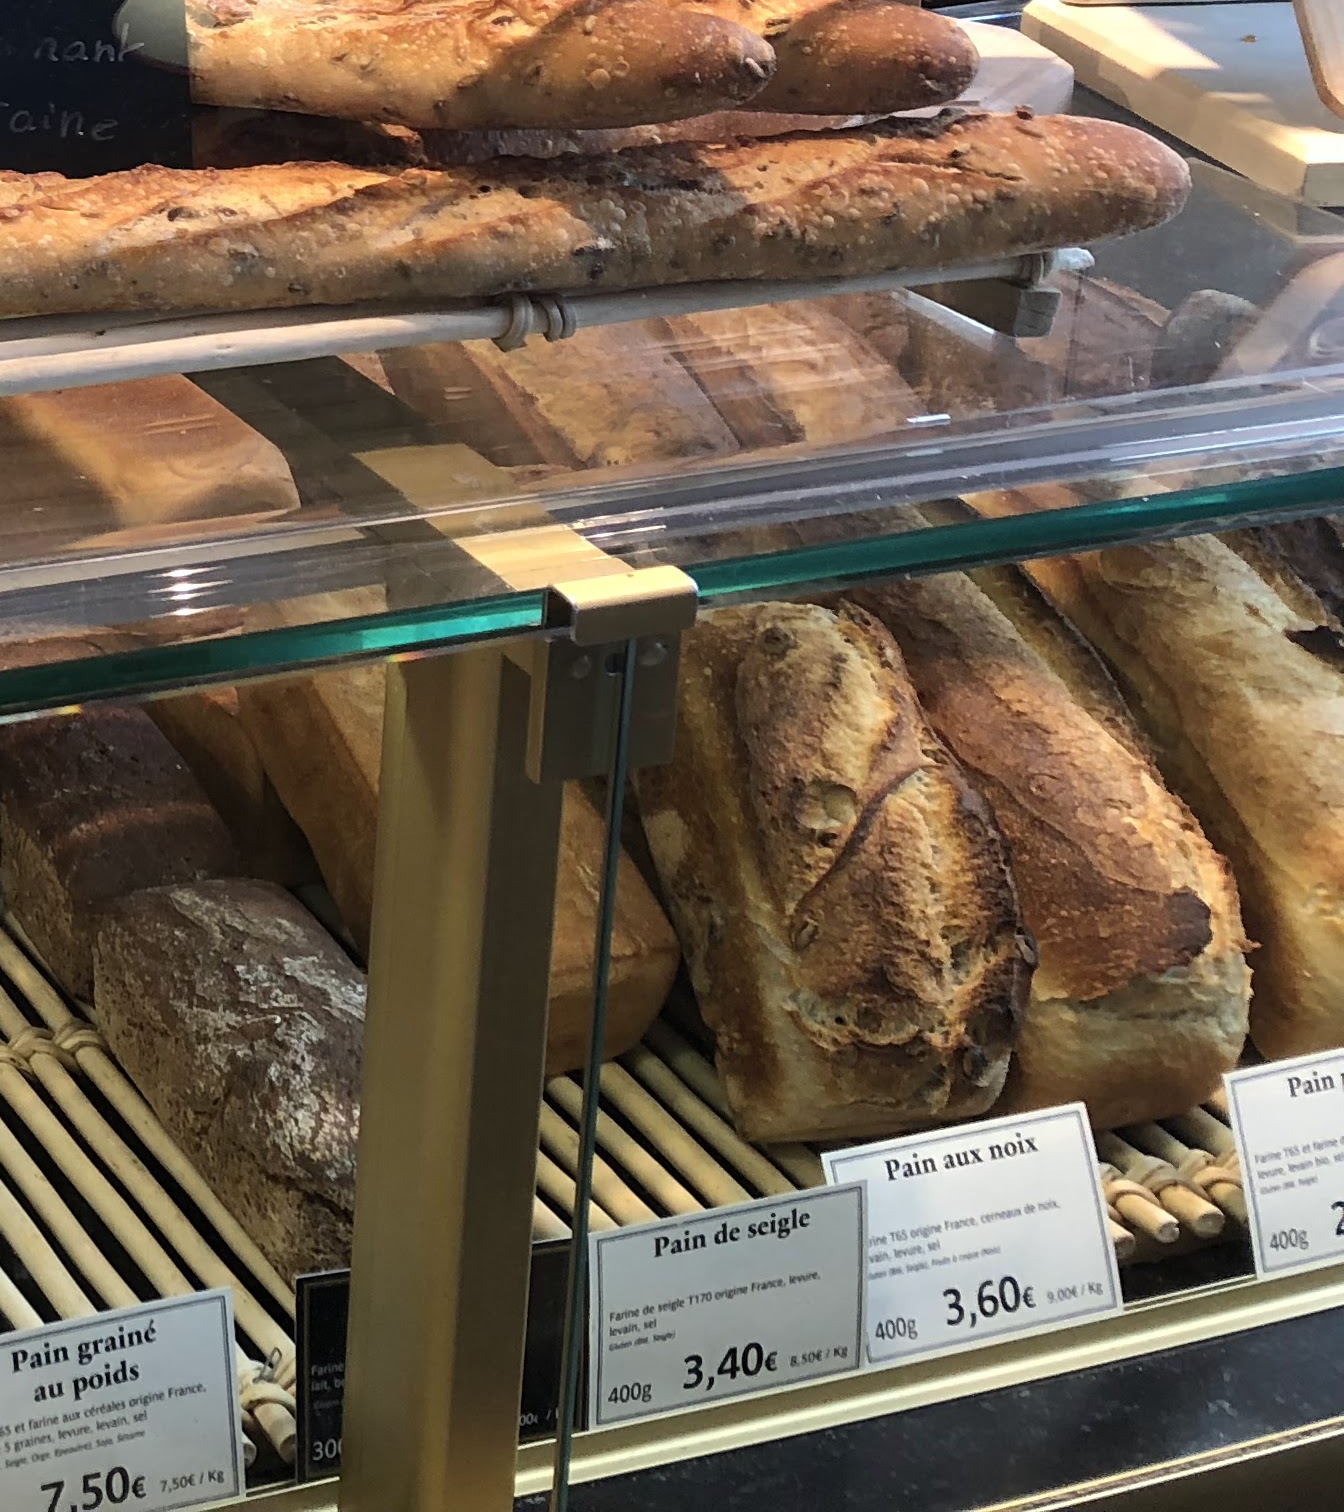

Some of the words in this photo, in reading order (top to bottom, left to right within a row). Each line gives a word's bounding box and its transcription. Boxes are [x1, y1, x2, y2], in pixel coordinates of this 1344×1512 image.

[1288, 1071, 1334, 1097] Pain
[884, 1153, 938, 1181] Pain
[943, 1148, 984, 1169] aux
[989, 1133, 1039, 1161] noix
[654, 1231, 707, 1258] Pain
[714, 1223, 741, 1244] de
[747, 1209, 811, 1239] seigle
[912, 1223, 942, 1239] origine
[1024, 1204, 1036, 1214] de
[1269, 1229, 1310, 1250] 400g
[610, 1307, 640, 1322] Farine
[643, 1305, 655, 1315] de
[658, 1298, 685, 1313] seigle
[715, 1285, 748, 1300] origine
[644, 1319, 657, 1329] sel
[875, 1317, 918, 1340] 400g
[943, 1276, 1037, 1328] 3,60€
[1089, 1281, 1103, 1294] Kg
[11, 1346, 70, 1372] Pain
[78, 1319, 157, 1366] grainé
[34, 1381, 64, 1402] au
[73, 1361, 140, 1401] poids
[608, 1382, 652, 1403] 400g
[683, 1342, 778, 1391] 3,40€
[834, 1346, 848, 1358] Kg
[14, 1424, 25, 1434] et
[28, 1416, 59, 1430] farine
[63, 1412, 80, 1422] aux
[84, 1401, 126, 1419] céréales
[129, 1391, 165, 1410] origine
[133, 1411, 148, 1422] sel
[41, 1466, 147, 1512] 7,50€
[160, 1476, 196, 1492] 7,50€
[208, 1469, 224, 1483] Kg
